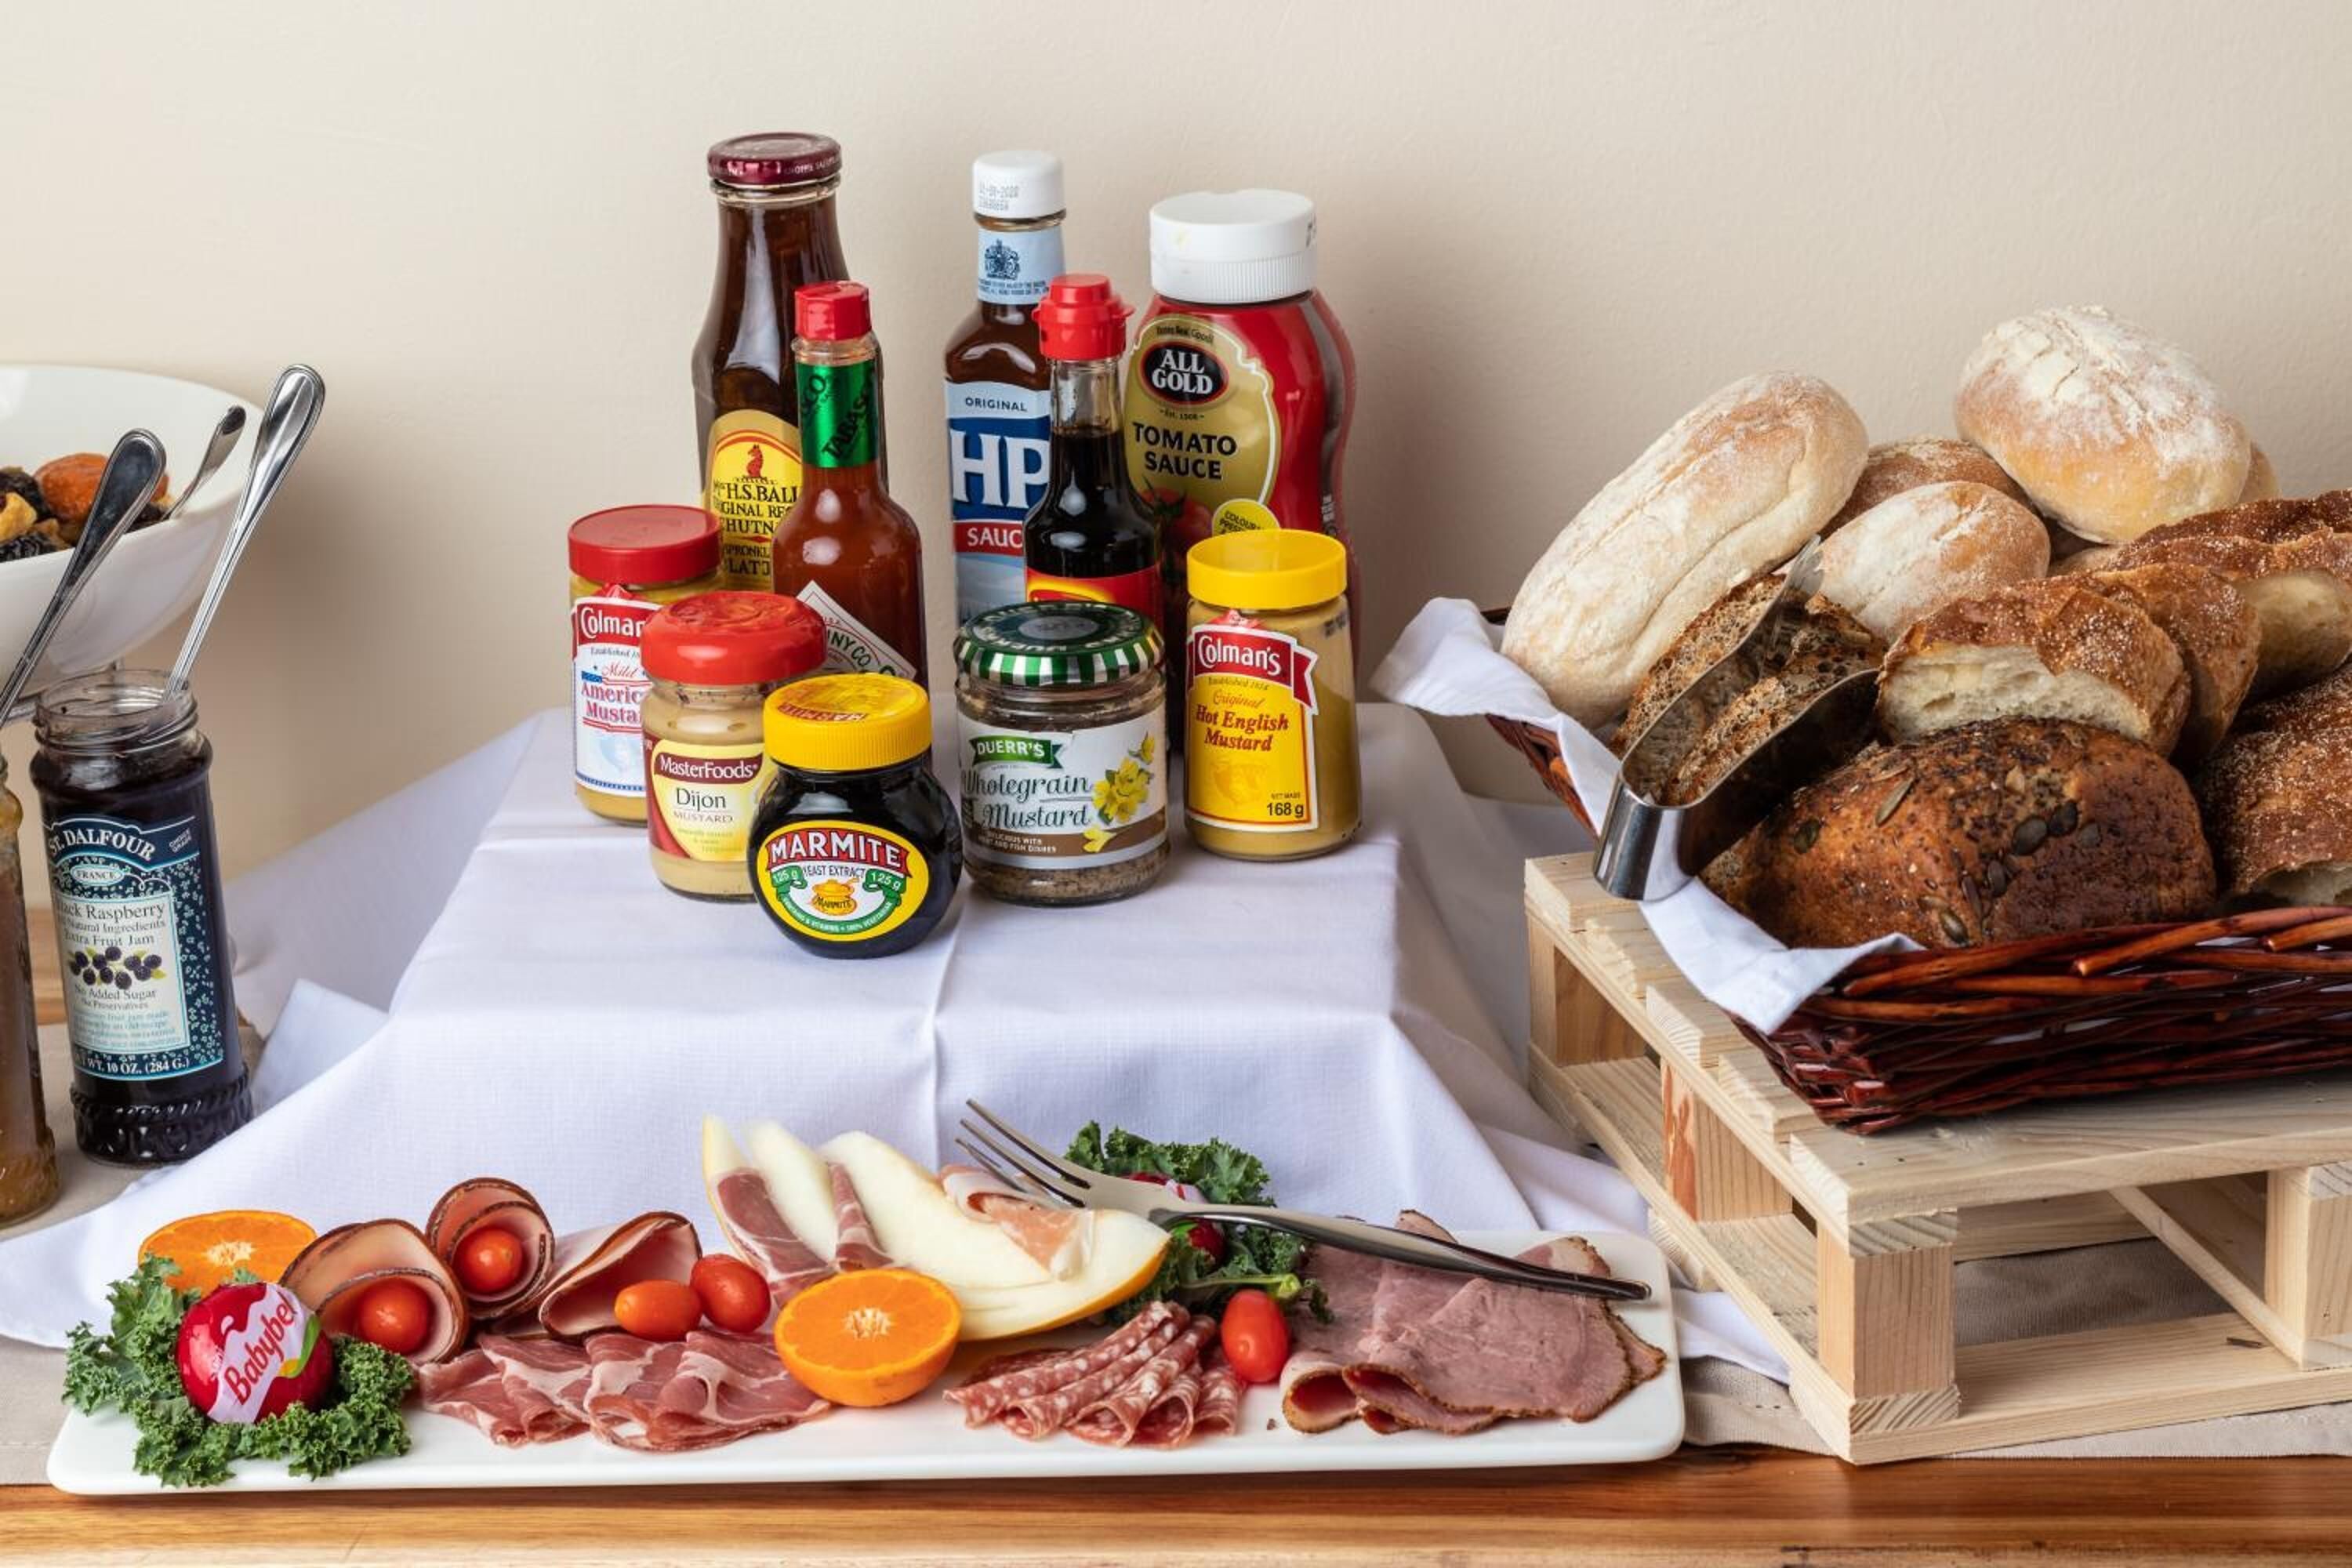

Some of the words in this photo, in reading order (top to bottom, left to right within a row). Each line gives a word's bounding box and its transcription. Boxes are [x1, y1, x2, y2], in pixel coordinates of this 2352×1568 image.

[1160, 349, 1205, 374] ALL
[1152, 369, 1214, 394] GOLD
[965, 397, 1027, 412] ORIGINAL
[1132, 421, 1238, 456] TOMATO
[949, 428, 1051, 509] HP
[1145, 452, 1223, 481] SAUCE
[723, 517, 775, 534] HUTN
[967, 527, 1023, 549] SAUC
[1197, 635, 1282, 676] Colman's
[601, 662, 640, 679] Mild
[582, 681, 644, 705] Americ
[1213, 689, 1267, 709] Original
[586, 699, 641, 725] Musta
[1196, 703, 1219, 724] Hot
[1222, 710, 1290, 735] English
[977, 739, 1046, 758] DUERR'S
[1204, 727, 1274, 752] Mustard
[961, 768, 1091, 804] Wholegrain
[677, 787, 727, 812] Dijon
[1267, 802, 1292, 817] 168
[1294, 804, 1305, 818] g
[673, 809, 734, 824] MUSTARD
[980, 803, 1091, 829] Mustard
[49, 838, 65, 855] ST.
[63, 828, 156, 862] DALFOUR
[771, 831, 902, 868] MARMITE
[77, 871, 115, 880] FRANCE
[773, 871, 790, 885] 125
[803, 865, 827, 877] YEAST
[829, 866, 866, 879] EXTRACT
[871, 872, 892, 886] 125
[891, 880, 902, 891] g
[86, 904, 165, 924] Raspberry
[103, 920, 166, 934] Ingredients
[93, 935, 123, 946] Fruit
[128, 934, 156, 946] Jam
[89, 987, 122, 1000] Added
[124, 988, 156, 1002] Sugar
[107, 1060, 118, 1073] 10
[120, 1062, 142, 1075] OZ.
[144, 1058, 170, 1075] (284
[172, 1057, 190, 1071] G.)
[223, 1291, 299, 1406] Babybel
